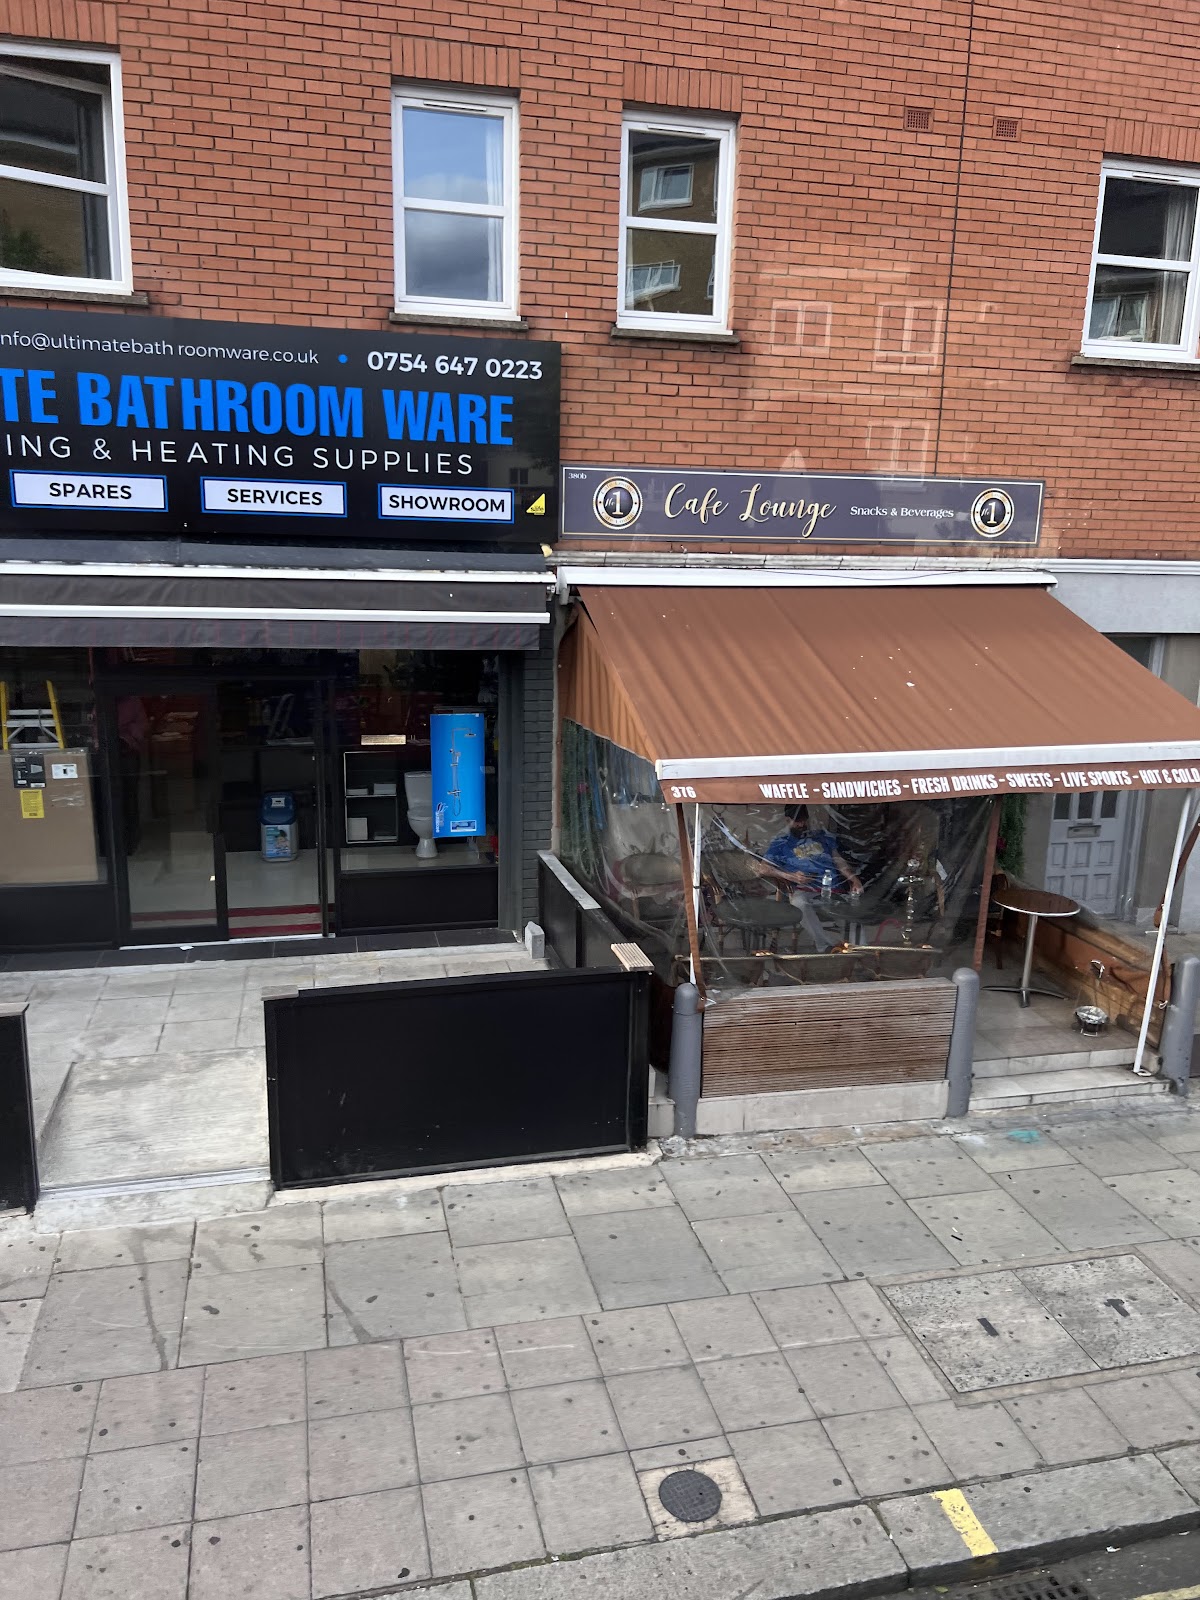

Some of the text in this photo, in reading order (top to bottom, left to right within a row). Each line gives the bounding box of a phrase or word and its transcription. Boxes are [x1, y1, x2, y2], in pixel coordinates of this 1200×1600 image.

[367, 351, 543, 380] 0754 647 0223
[0, 368, 513, 445] TE BATHROOM WARE
[6, 433, 473, 475] ING & HEATING SUPPLIES
[568, 472, 587, 480] 380b
[49, 482, 132, 500] SPARES
[227, 488, 323, 506] SERVICES
[612, 490, 624, 515] 1
[389, 494, 505, 513] SHOWROOM
[664, 482, 837, 538] Cafe Lounge
[850, 506, 954, 519] Snacks & Beverages
[986, 501, 997, 524] 1
[671, 786, 697, 799] 376
[759, 783, 809, 799] WAFFLE
[821, 779, 901, 799] SANDWICHES
[911, 775, 950, 795] FRESH
[951, 774, 998, 791] DRINKS
[1005, 772, 1053, 788] SWEETS
[1060, 771, 1089, 788] LIVE
[1087, 770, 1132, 786] SPORTS
[1138, 769, 1163, 784] HOT
[1171, 767, 1200, 784] COLD
